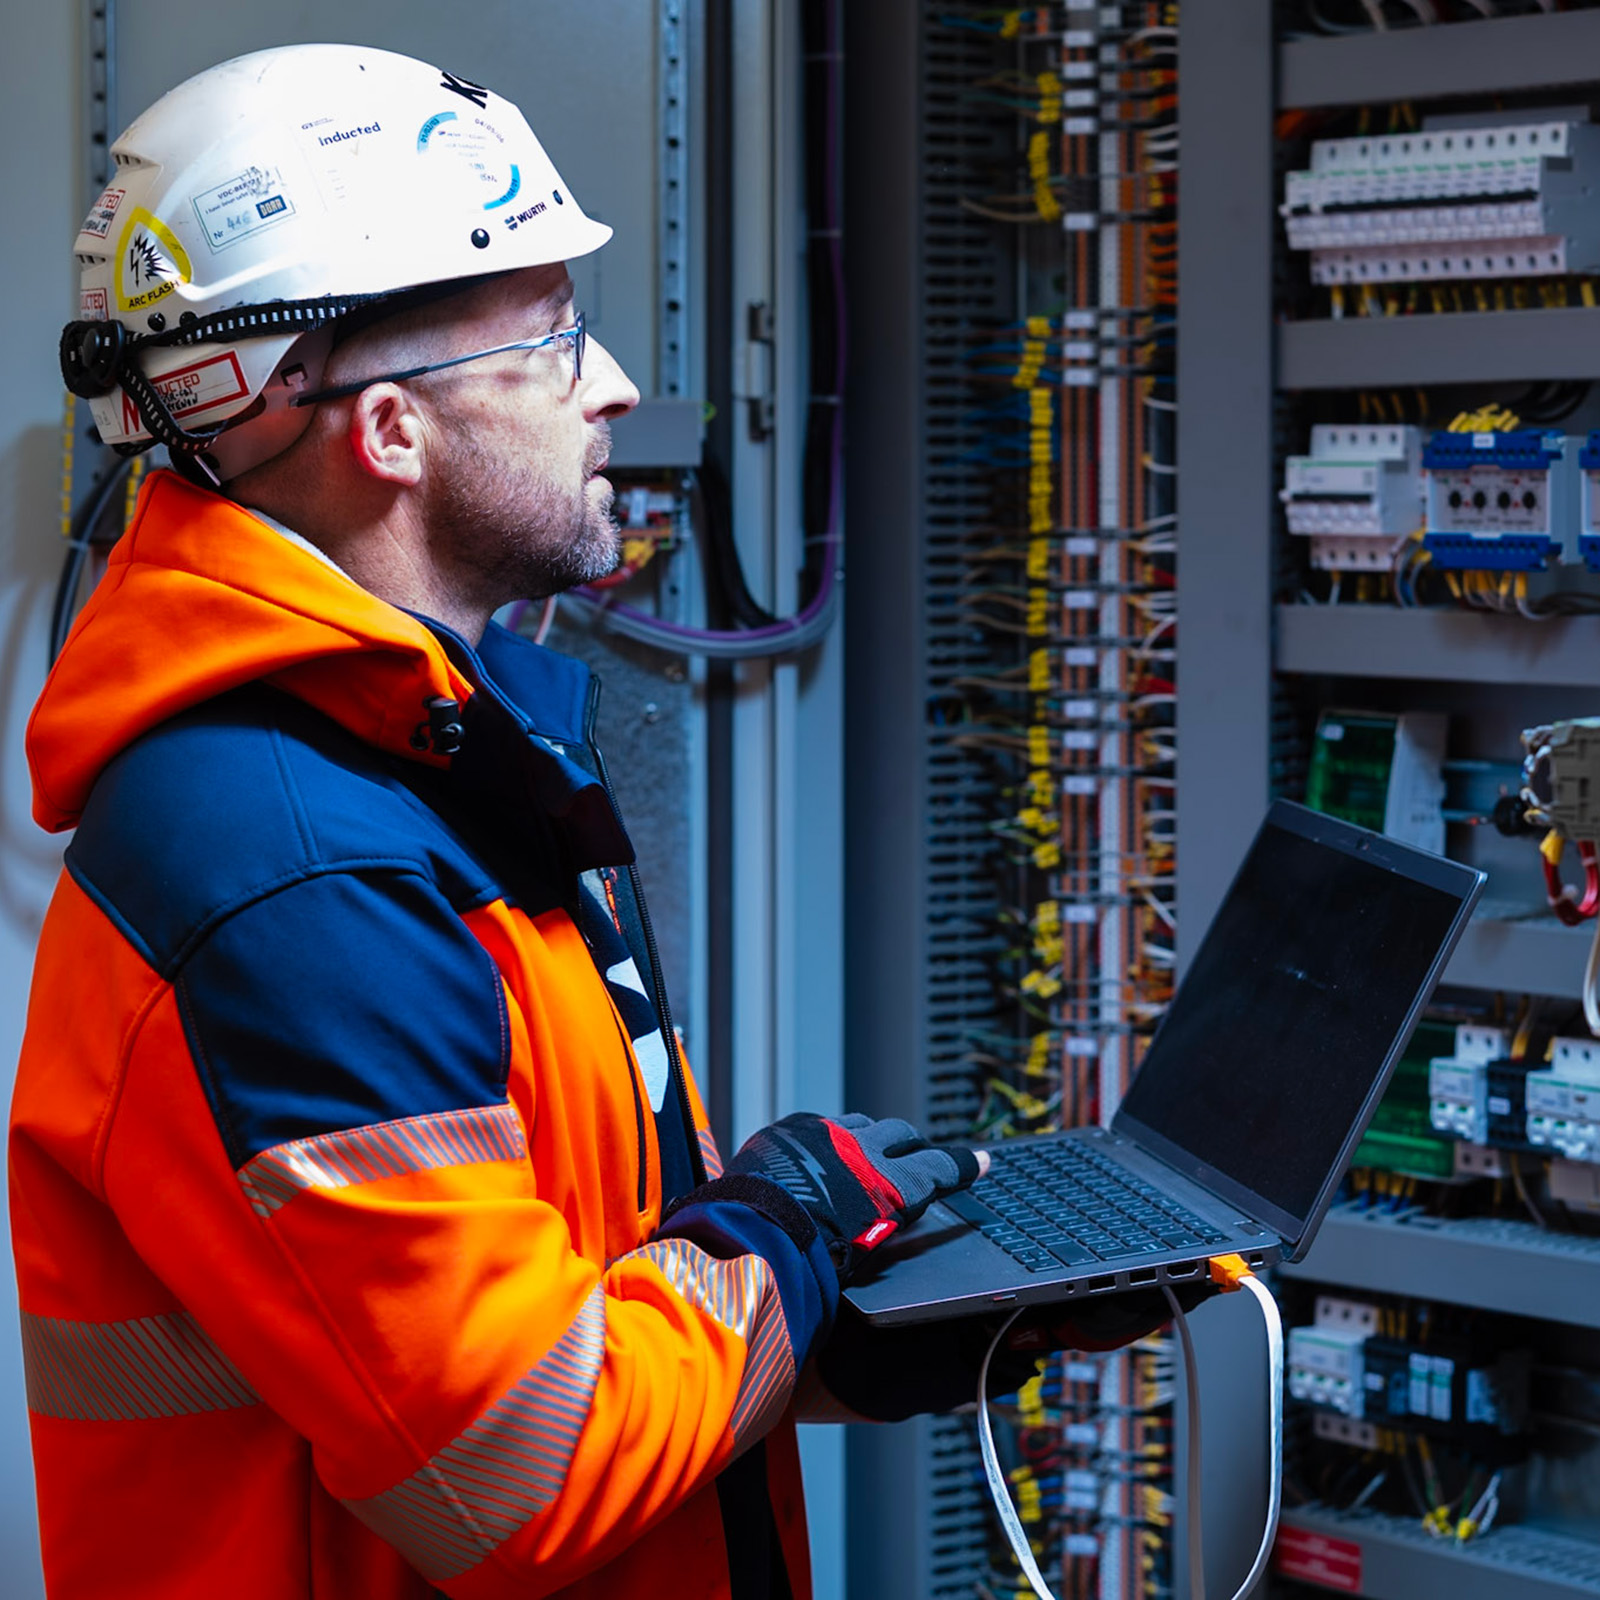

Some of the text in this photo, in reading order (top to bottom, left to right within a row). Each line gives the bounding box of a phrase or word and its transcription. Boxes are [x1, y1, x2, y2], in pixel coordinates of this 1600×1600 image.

[440, 71, 488, 109] K
[318, 121, 382, 146] Inducted
[128, 279, 180, 309] ARC FLASH
